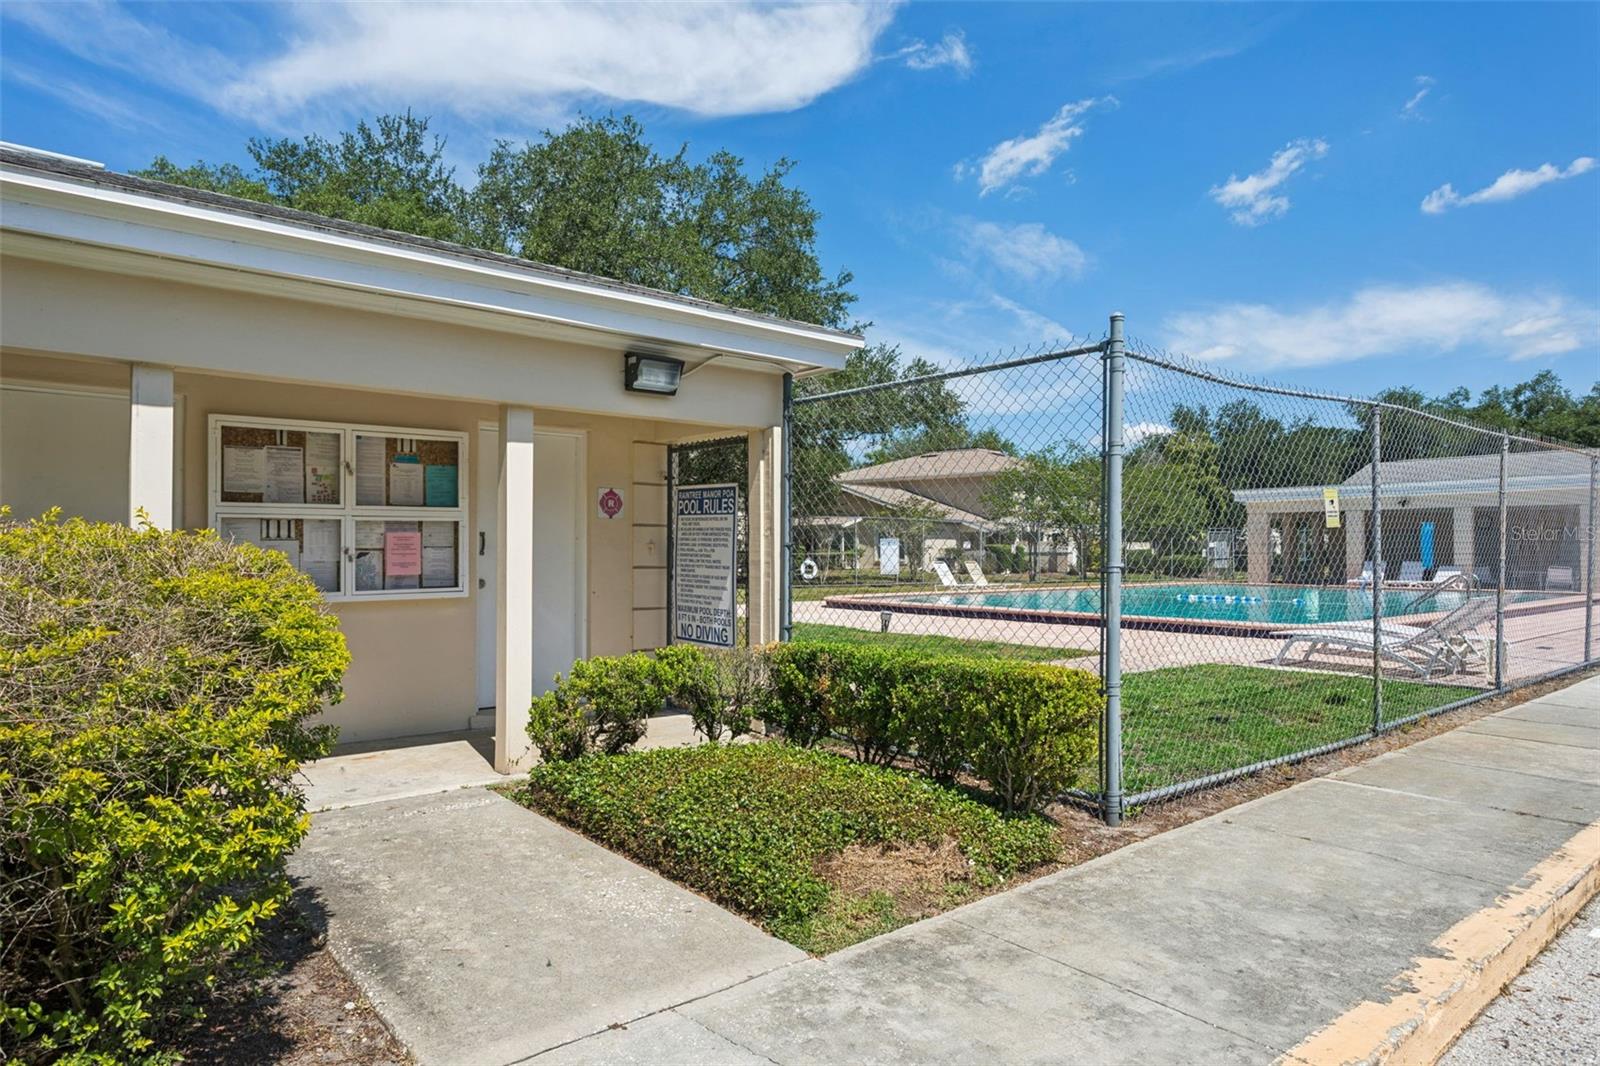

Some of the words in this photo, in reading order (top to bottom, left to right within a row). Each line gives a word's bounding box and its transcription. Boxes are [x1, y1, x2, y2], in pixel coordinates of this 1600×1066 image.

[678, 500, 702, 514] POOL
[704, 498, 734, 513] RULES
[700, 607, 712, 616] POOL
[714, 618, 731, 627] POOLS
[681, 623, 693, 637] NO
[696, 625, 728, 642] DIVING
